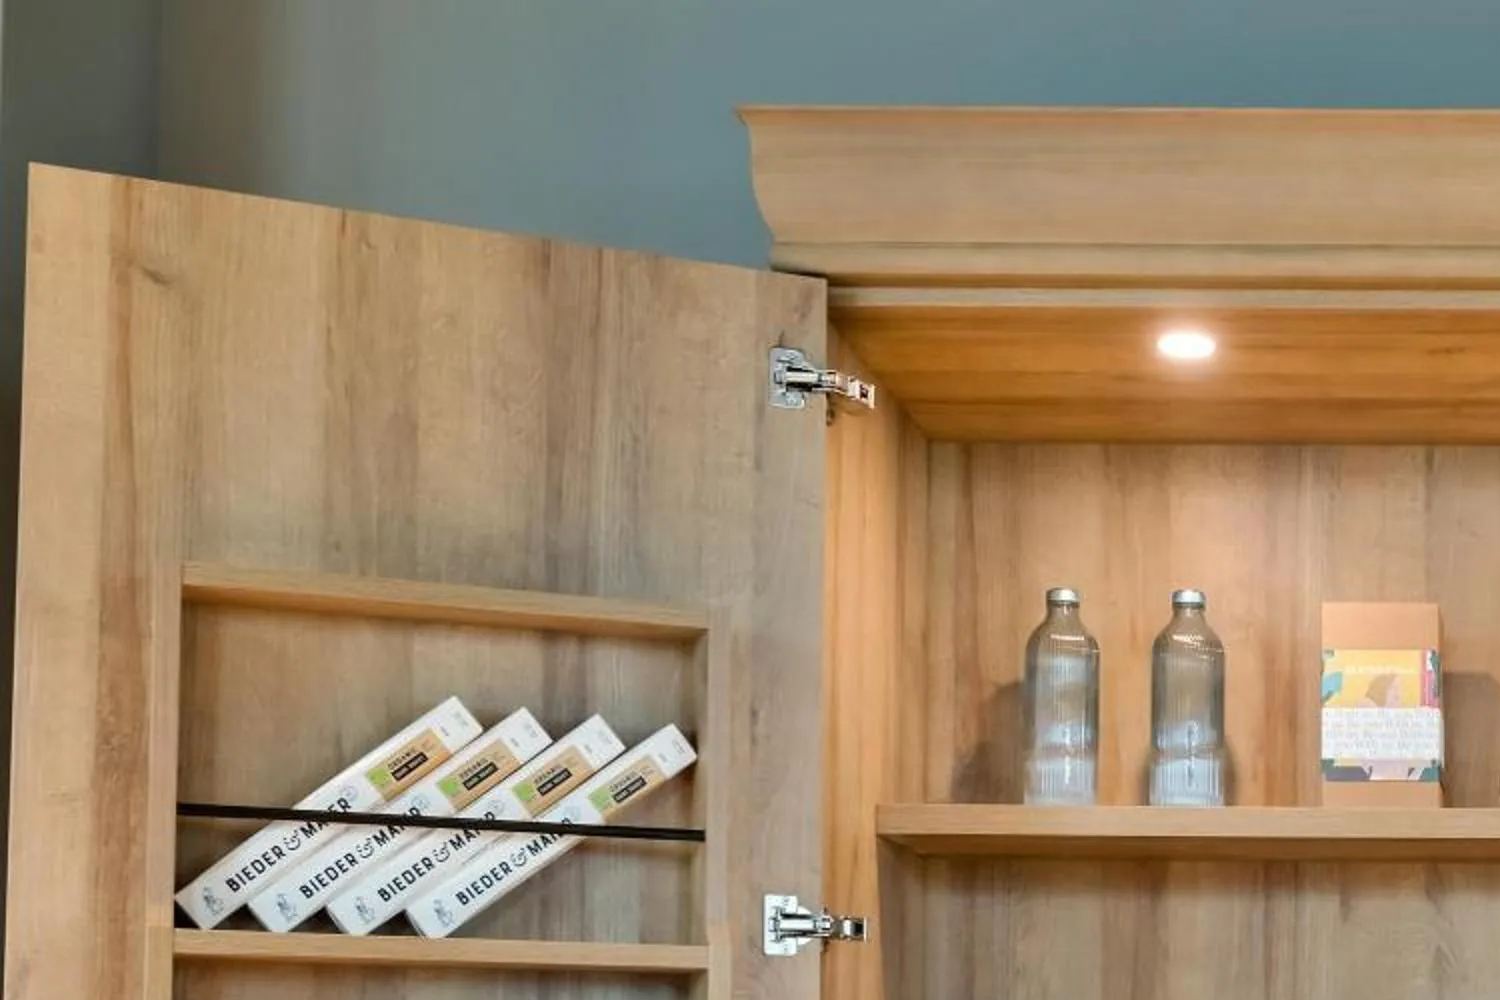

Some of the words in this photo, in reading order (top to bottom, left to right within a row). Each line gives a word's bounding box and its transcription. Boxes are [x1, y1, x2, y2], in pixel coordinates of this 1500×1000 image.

[225, 845, 286, 893] BIEDER
[300, 797, 352, 839] MAER
[299, 852, 359, 900] BIEDER
[372, 806, 421, 848] MAIR
[377, 856, 436, 902] BIEDER
[449, 811, 496, 852] MAIR
[455, 861, 513, 906] BIEDER
[526, 817, 574, 857] MAI
